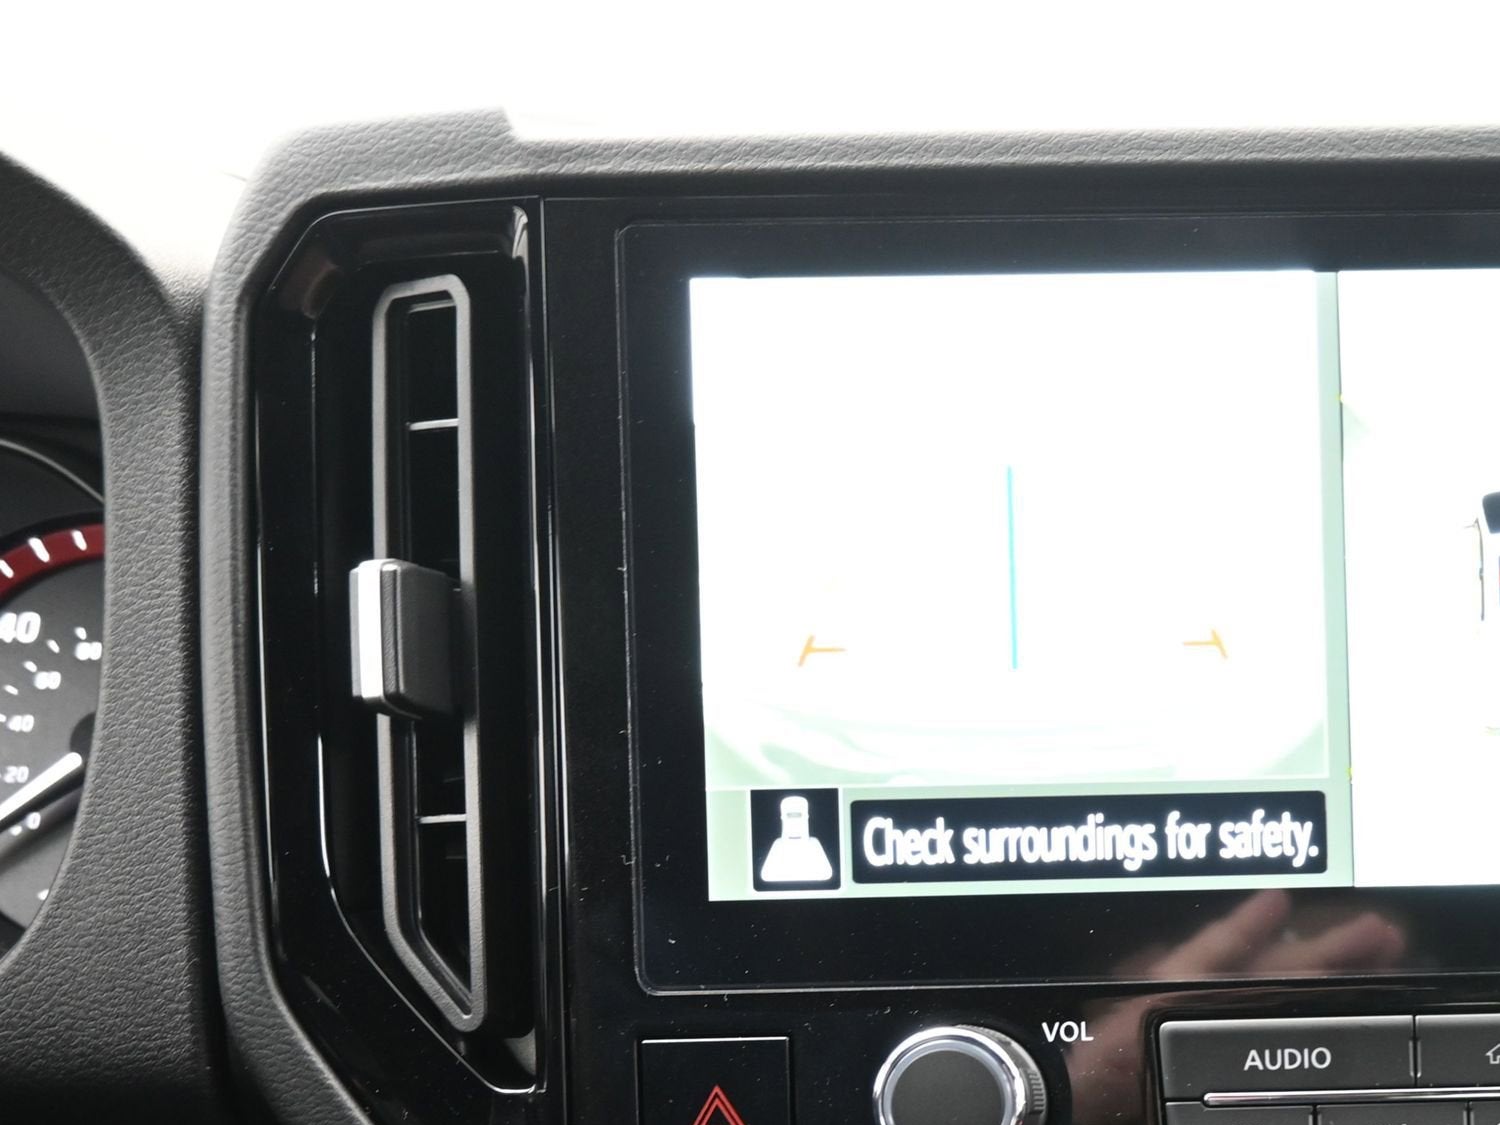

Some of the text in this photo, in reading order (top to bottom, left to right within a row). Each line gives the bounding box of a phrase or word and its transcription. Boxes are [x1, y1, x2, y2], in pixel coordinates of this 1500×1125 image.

[3, 765, 30, 784] 20
[862, 808, 1320, 872] Check surroundings for safety.
[1041, 1020, 1095, 1043] VOL
[1243, 1046, 1332, 1071] AUDIO
